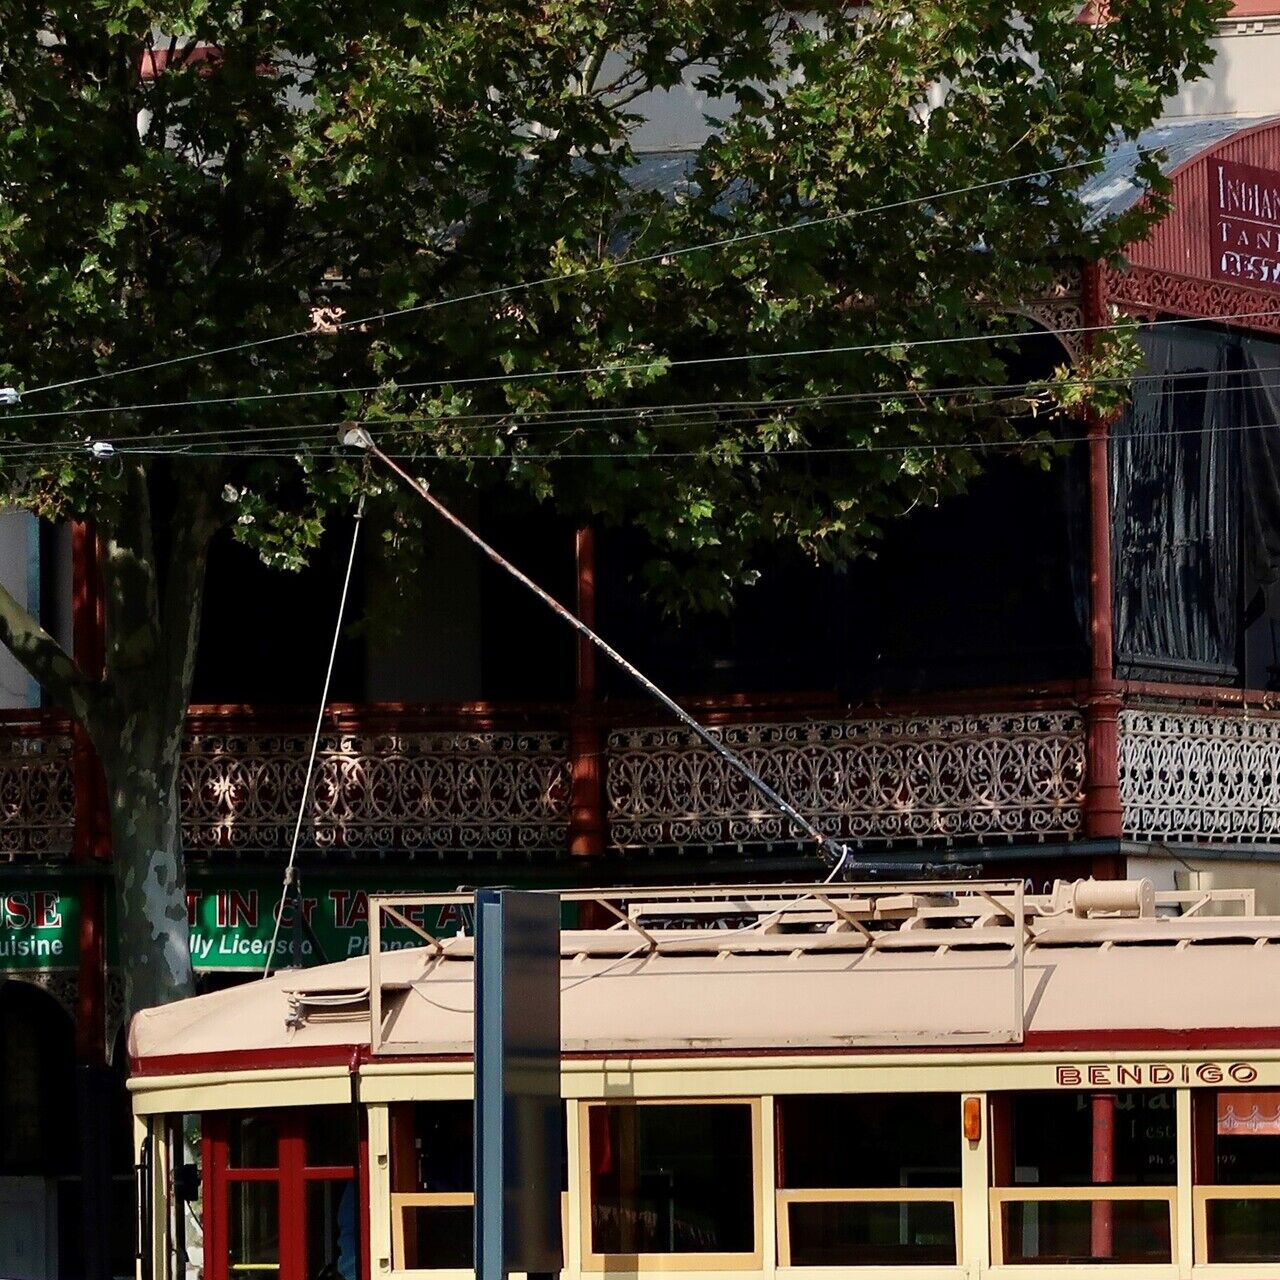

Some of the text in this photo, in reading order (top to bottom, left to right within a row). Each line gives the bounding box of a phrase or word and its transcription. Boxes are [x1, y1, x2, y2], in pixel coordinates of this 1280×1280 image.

[0, 890, 62, 928] SE
[216, 889, 258, 928] IN
[1056, 1063, 1259, 1086] BENDIGO
